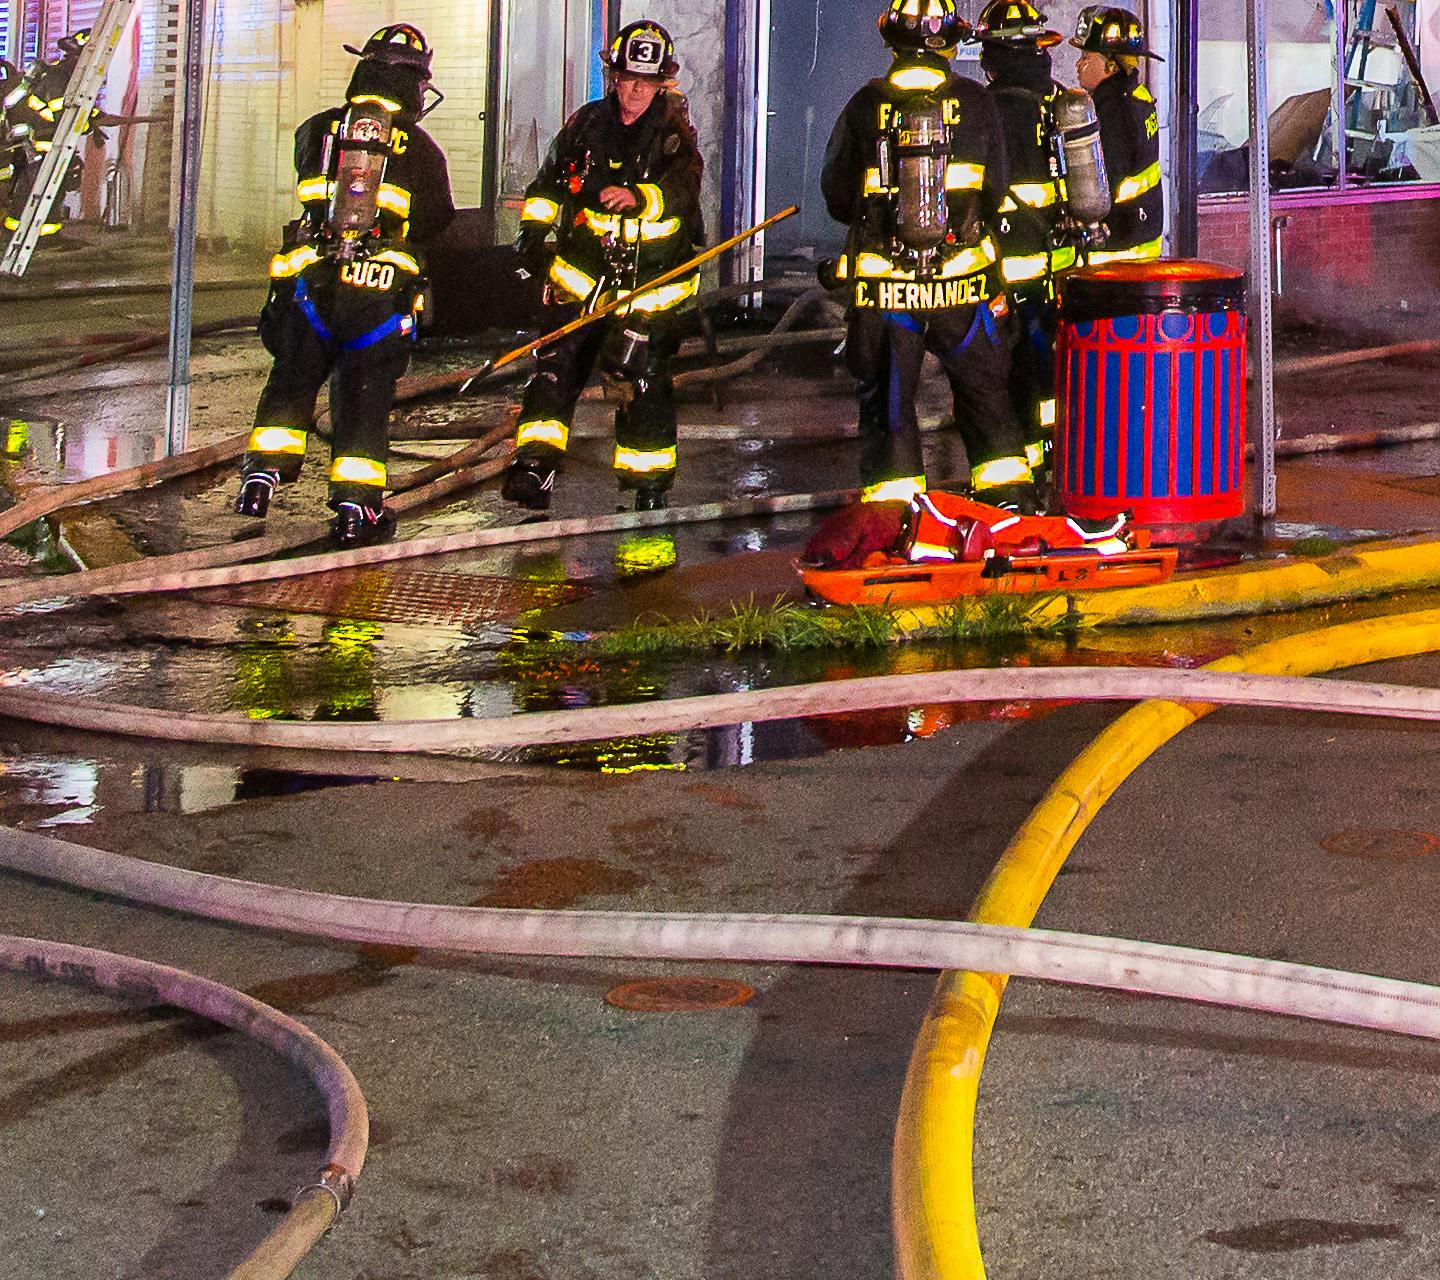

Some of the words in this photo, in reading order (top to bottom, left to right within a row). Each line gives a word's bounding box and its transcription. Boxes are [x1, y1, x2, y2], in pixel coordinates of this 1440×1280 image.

[637, 42, 654, 61] 3
[856, 281, 875, 308] C.
[879, 274, 990, 309] HERNANDEZ
